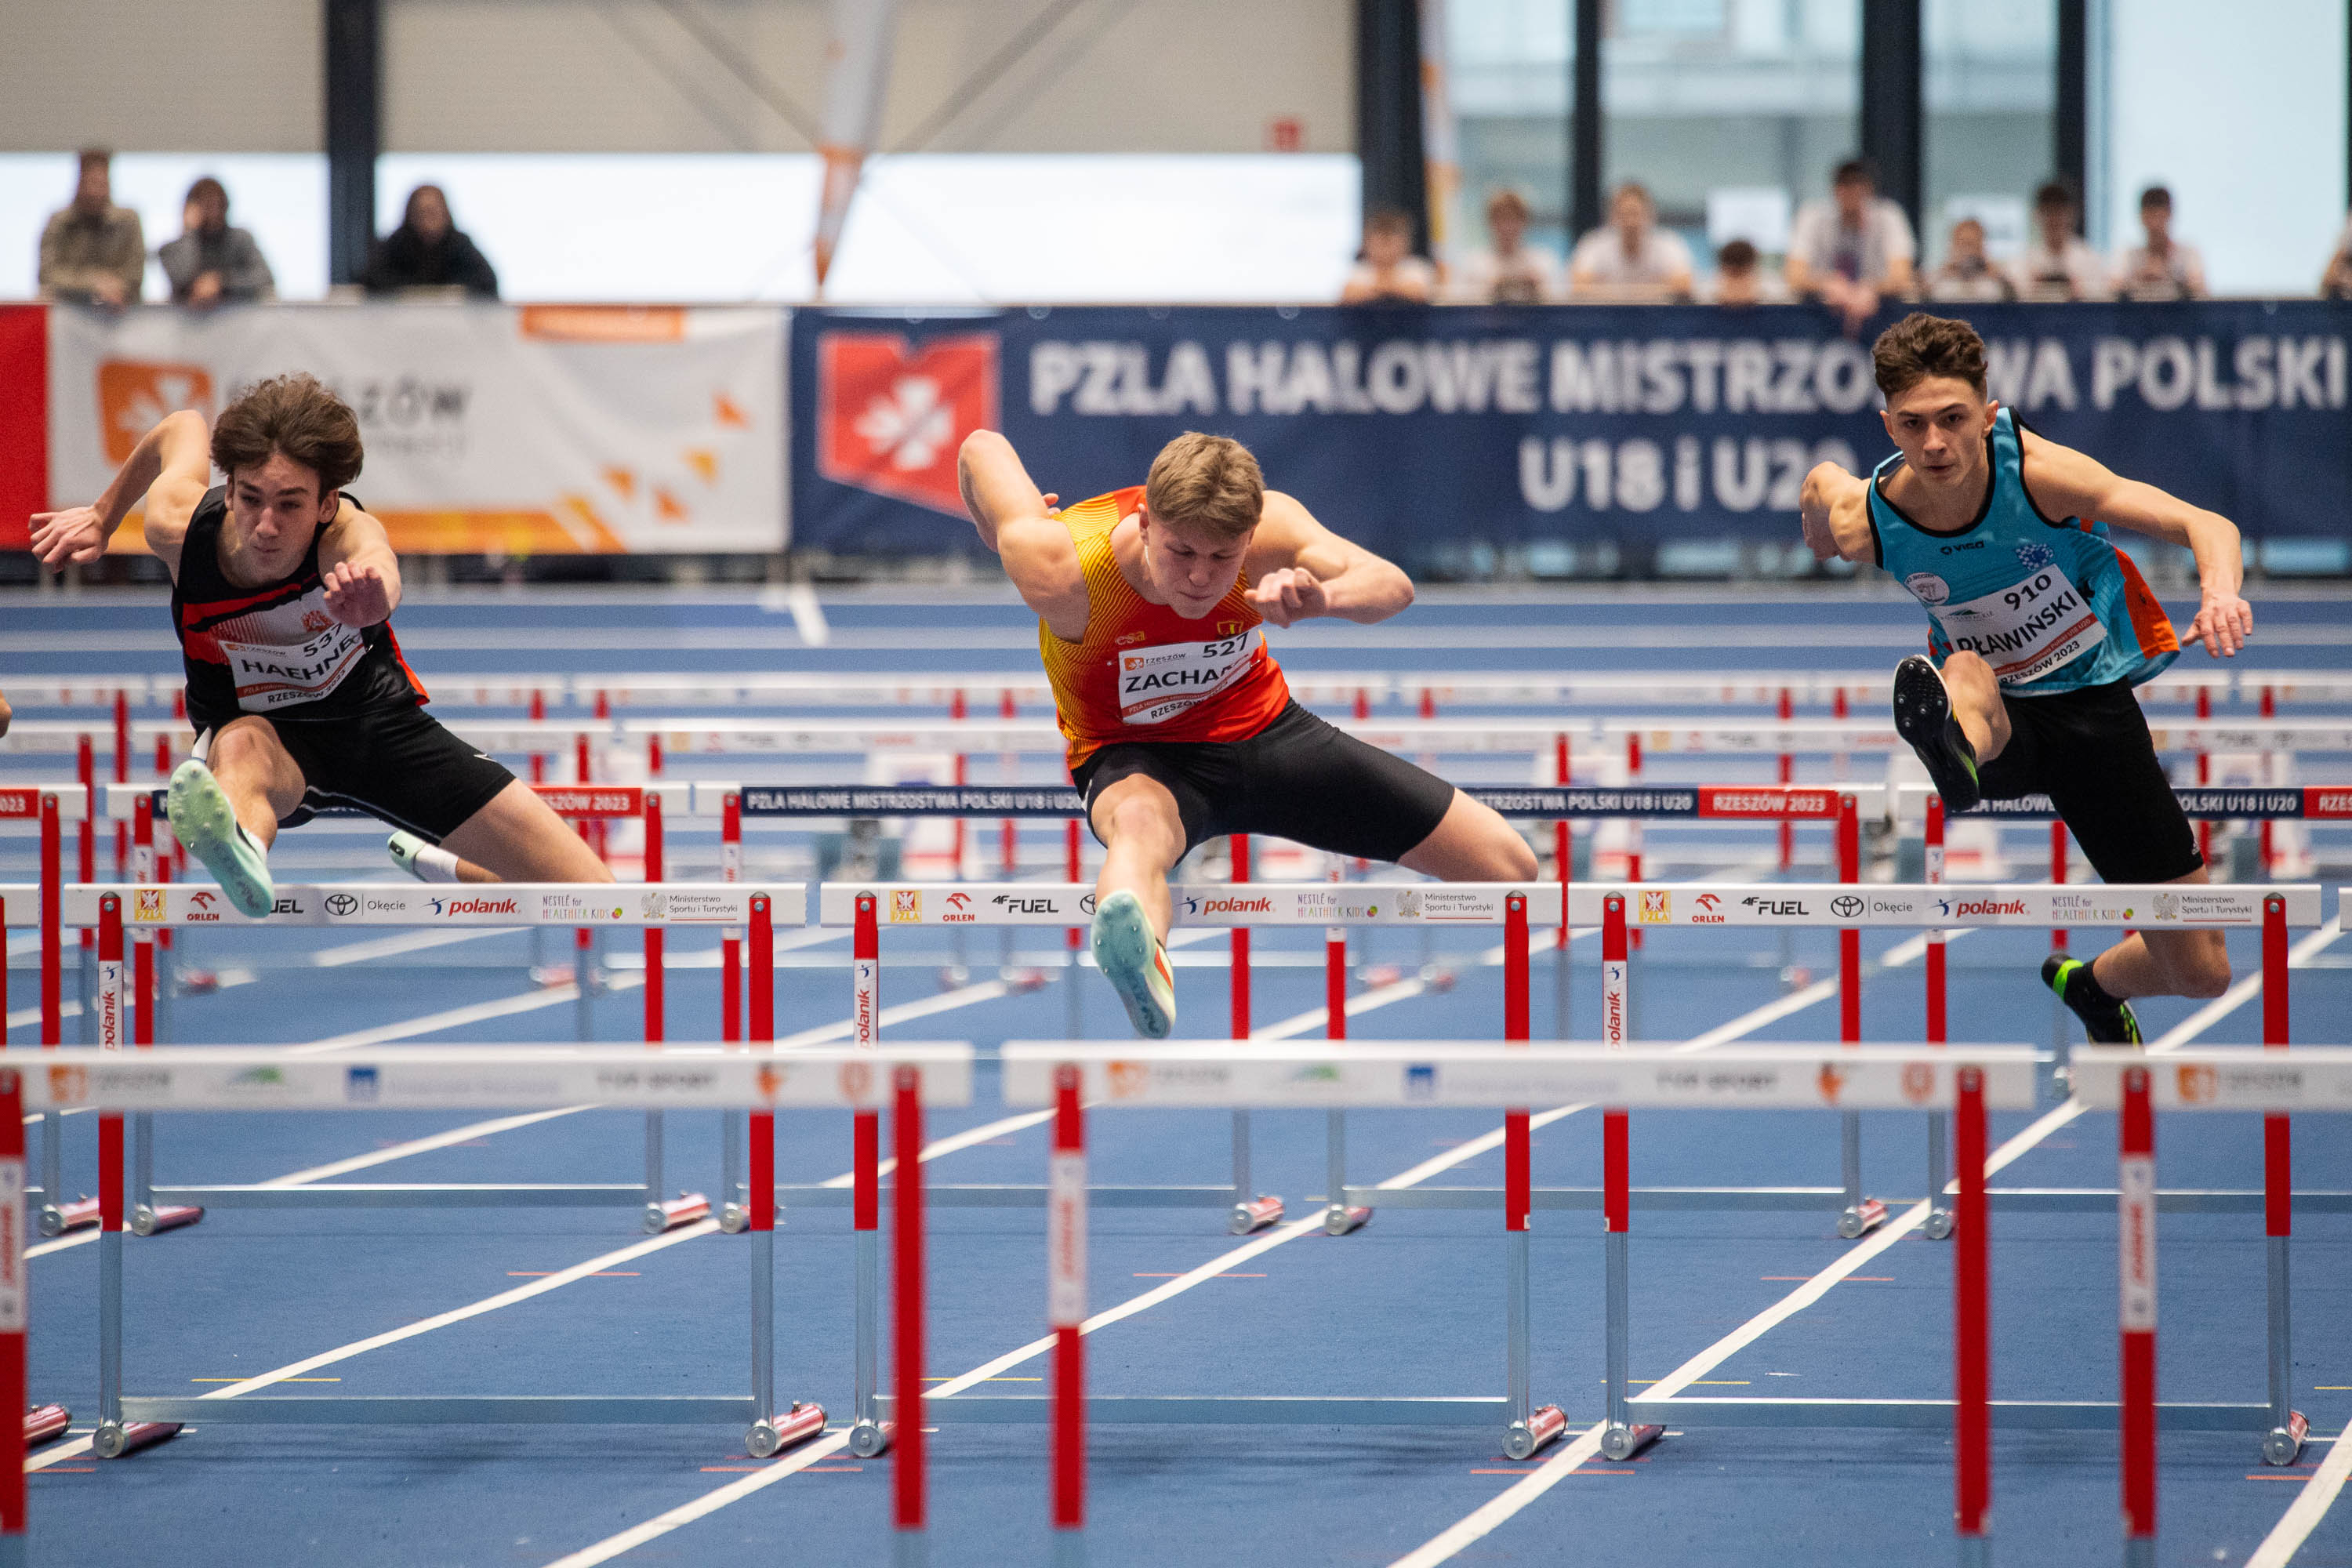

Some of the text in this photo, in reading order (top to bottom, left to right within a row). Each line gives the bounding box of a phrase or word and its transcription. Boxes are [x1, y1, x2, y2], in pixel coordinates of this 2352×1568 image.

[1029, 336, 2347, 416] PZLA HALOWE MISTRZOWA POLSKI
[1519, 436, 1665, 512] U18
[1672, 434, 1700, 513] i
[2004, 574, 2052, 612] 910
[303, 622, 343, 657] 537
[1203, 631, 1249, 658] 527
[2001, 657, 2053, 684] RZESZÓW
[2054, 641, 2080, 662] 2023
[0, 795, 26, 813] 023
[593, 793, 630, 811] 2023
[747, 791, 784, 809] PZLA
[787, 791, 851, 809] HALOWE
[852, 791, 959, 809] MISTRZOSTWA
[960, 792, 1014, 810] POLSKI
[1015, 792, 1045, 810] U18
[1568, 793, 1621, 811] POLSKI
[1622, 793, 1652, 811] U18
[1661, 793, 1693, 811] U20
[1713, 793, 1787, 811] RZESZÓW
[1788, 793, 1826, 812] 2023
[2177, 793, 2224, 811] OLSKI
[2227, 793, 2257, 812] U18
[2267, 793, 2297, 812] U20
[2318, 794, 2352, 812] RZES
[270, 899, 304, 914] UEL
[367, 900, 406, 912] Okęcie
[543, 895, 582, 907] NESTLÉ for
[670, 895, 720, 903] Ministerstwo
[991, 895, 1059, 913] 4F FUEL
[1203, 896, 1272, 916] polanik
[1298, 893, 1324, 905] NESTLÉ
[1425, 893, 1476, 902] Ministerstwo
[1741, 896, 1809, 916] 4F FUEL
[2052, 895, 2079, 907] NESTLÉ
[448, 898, 517, 917] polanik
[543, 909, 610, 920] HEALTHIER KIDS
[670, 905, 695, 914] Sportu
[702, 905, 738, 914] Turystyki
[1298, 906, 1365, 918] HEALTHIER KIDS
[1425, 903, 1451, 912] Sportu
[1458, 903, 1494, 913] Turystyki
[1874, 902, 1913, 913] Okęcie
[1956, 898, 2026, 918] polanik
[2052, 909, 2122, 920] HEALTHIER KIDS
[2182, 906, 2209, 914] Sportu
[2216, 906, 2252, 915] Turystyki
